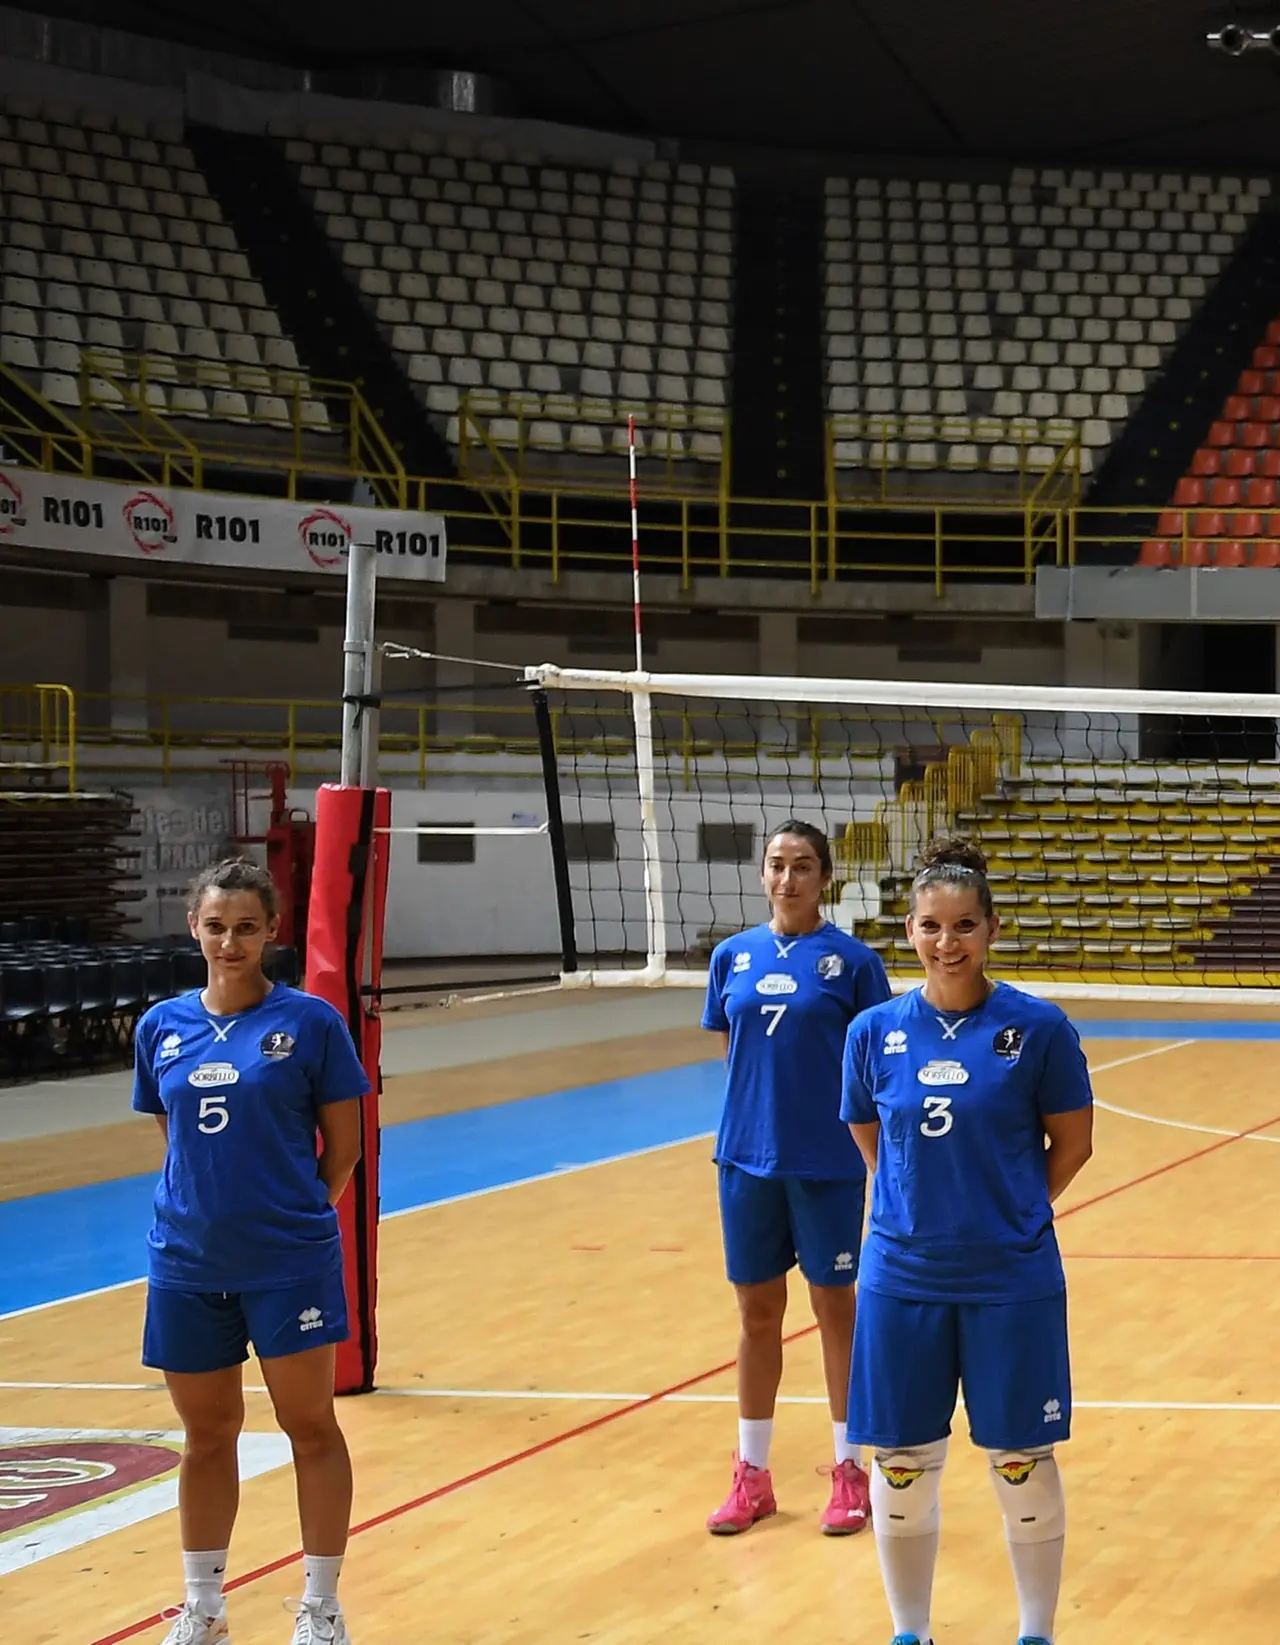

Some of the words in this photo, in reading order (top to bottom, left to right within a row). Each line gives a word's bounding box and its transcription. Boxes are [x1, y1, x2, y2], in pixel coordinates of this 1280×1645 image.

[0, 498, 17, 515] 01
[42, 496, 104, 529] R101
[133, 516, 168, 532] R101
[196, 513, 260, 543] R101
[308, 531, 345, 547] R101
[375, 530, 440, 557] R101
[760, 1004, 787, 1036] 7
[198, 1095, 230, 1134] 5
[919, 1095, 955, 1138] 3
